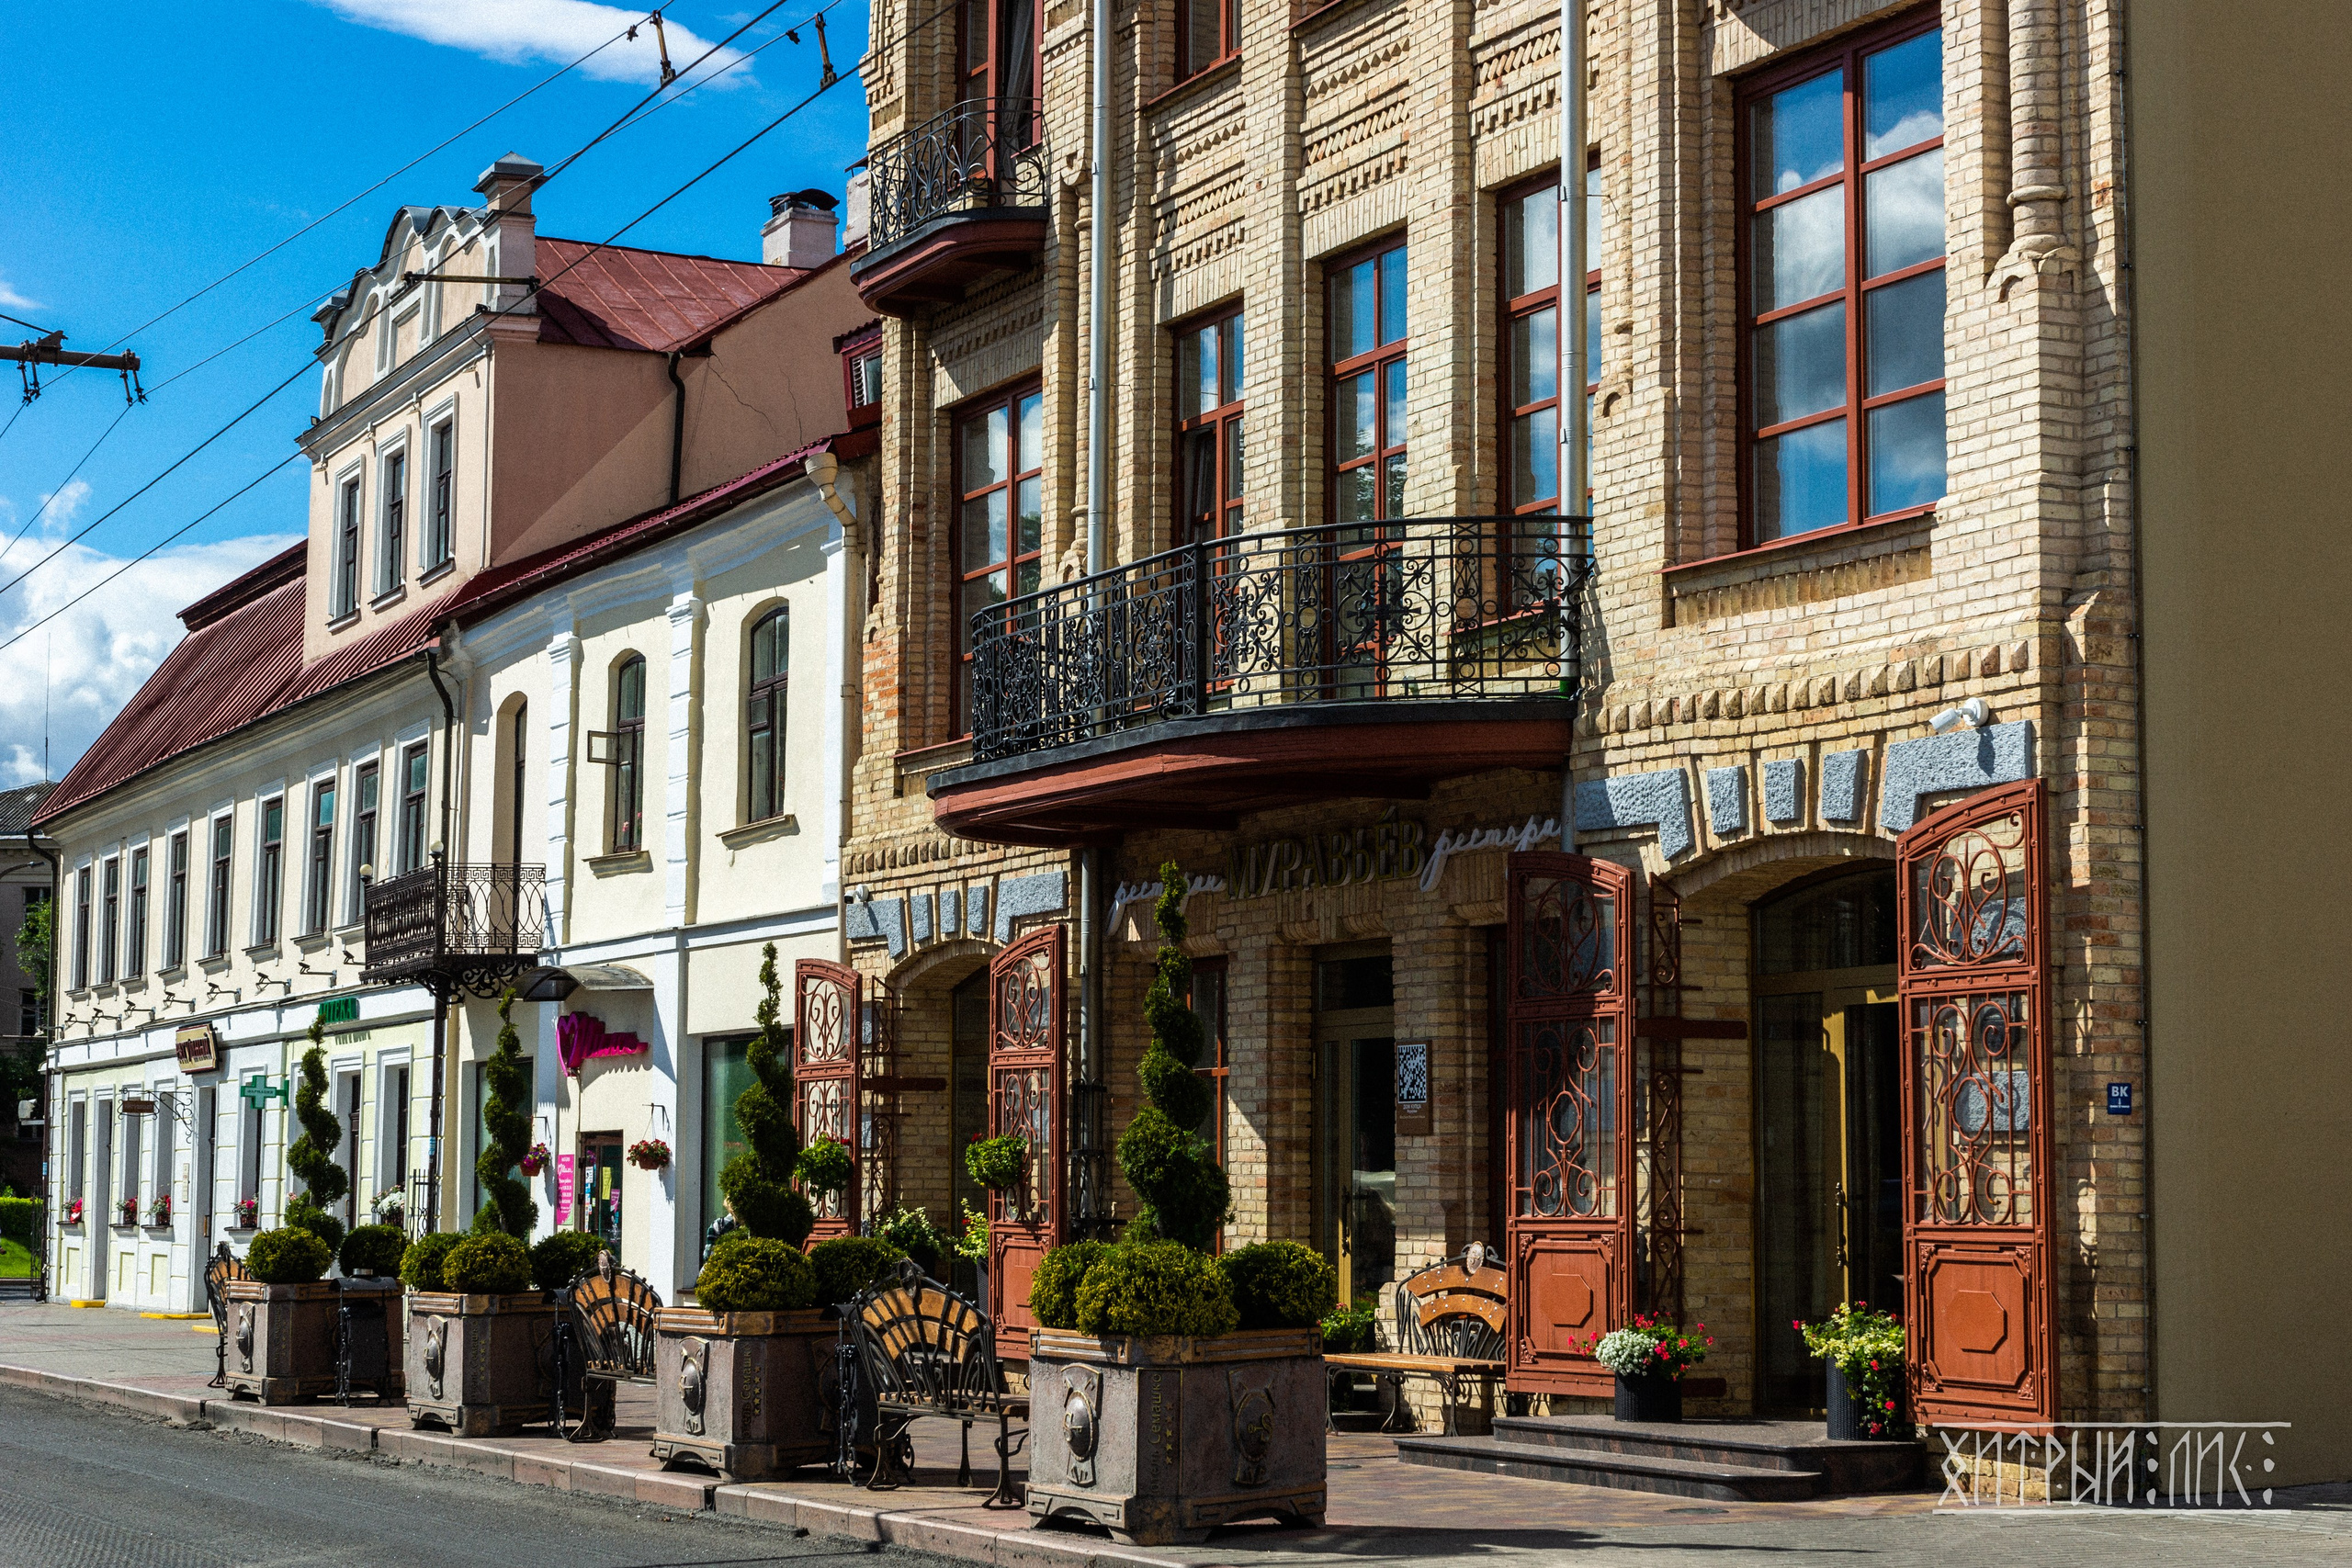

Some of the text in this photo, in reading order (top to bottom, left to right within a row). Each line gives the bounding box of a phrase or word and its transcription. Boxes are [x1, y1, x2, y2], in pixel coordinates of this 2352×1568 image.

[1105, 871, 1227, 936] рестран
[1419, 814, 1562, 894] рестора
[1148, 1374, 1162, 1445] Семашко
